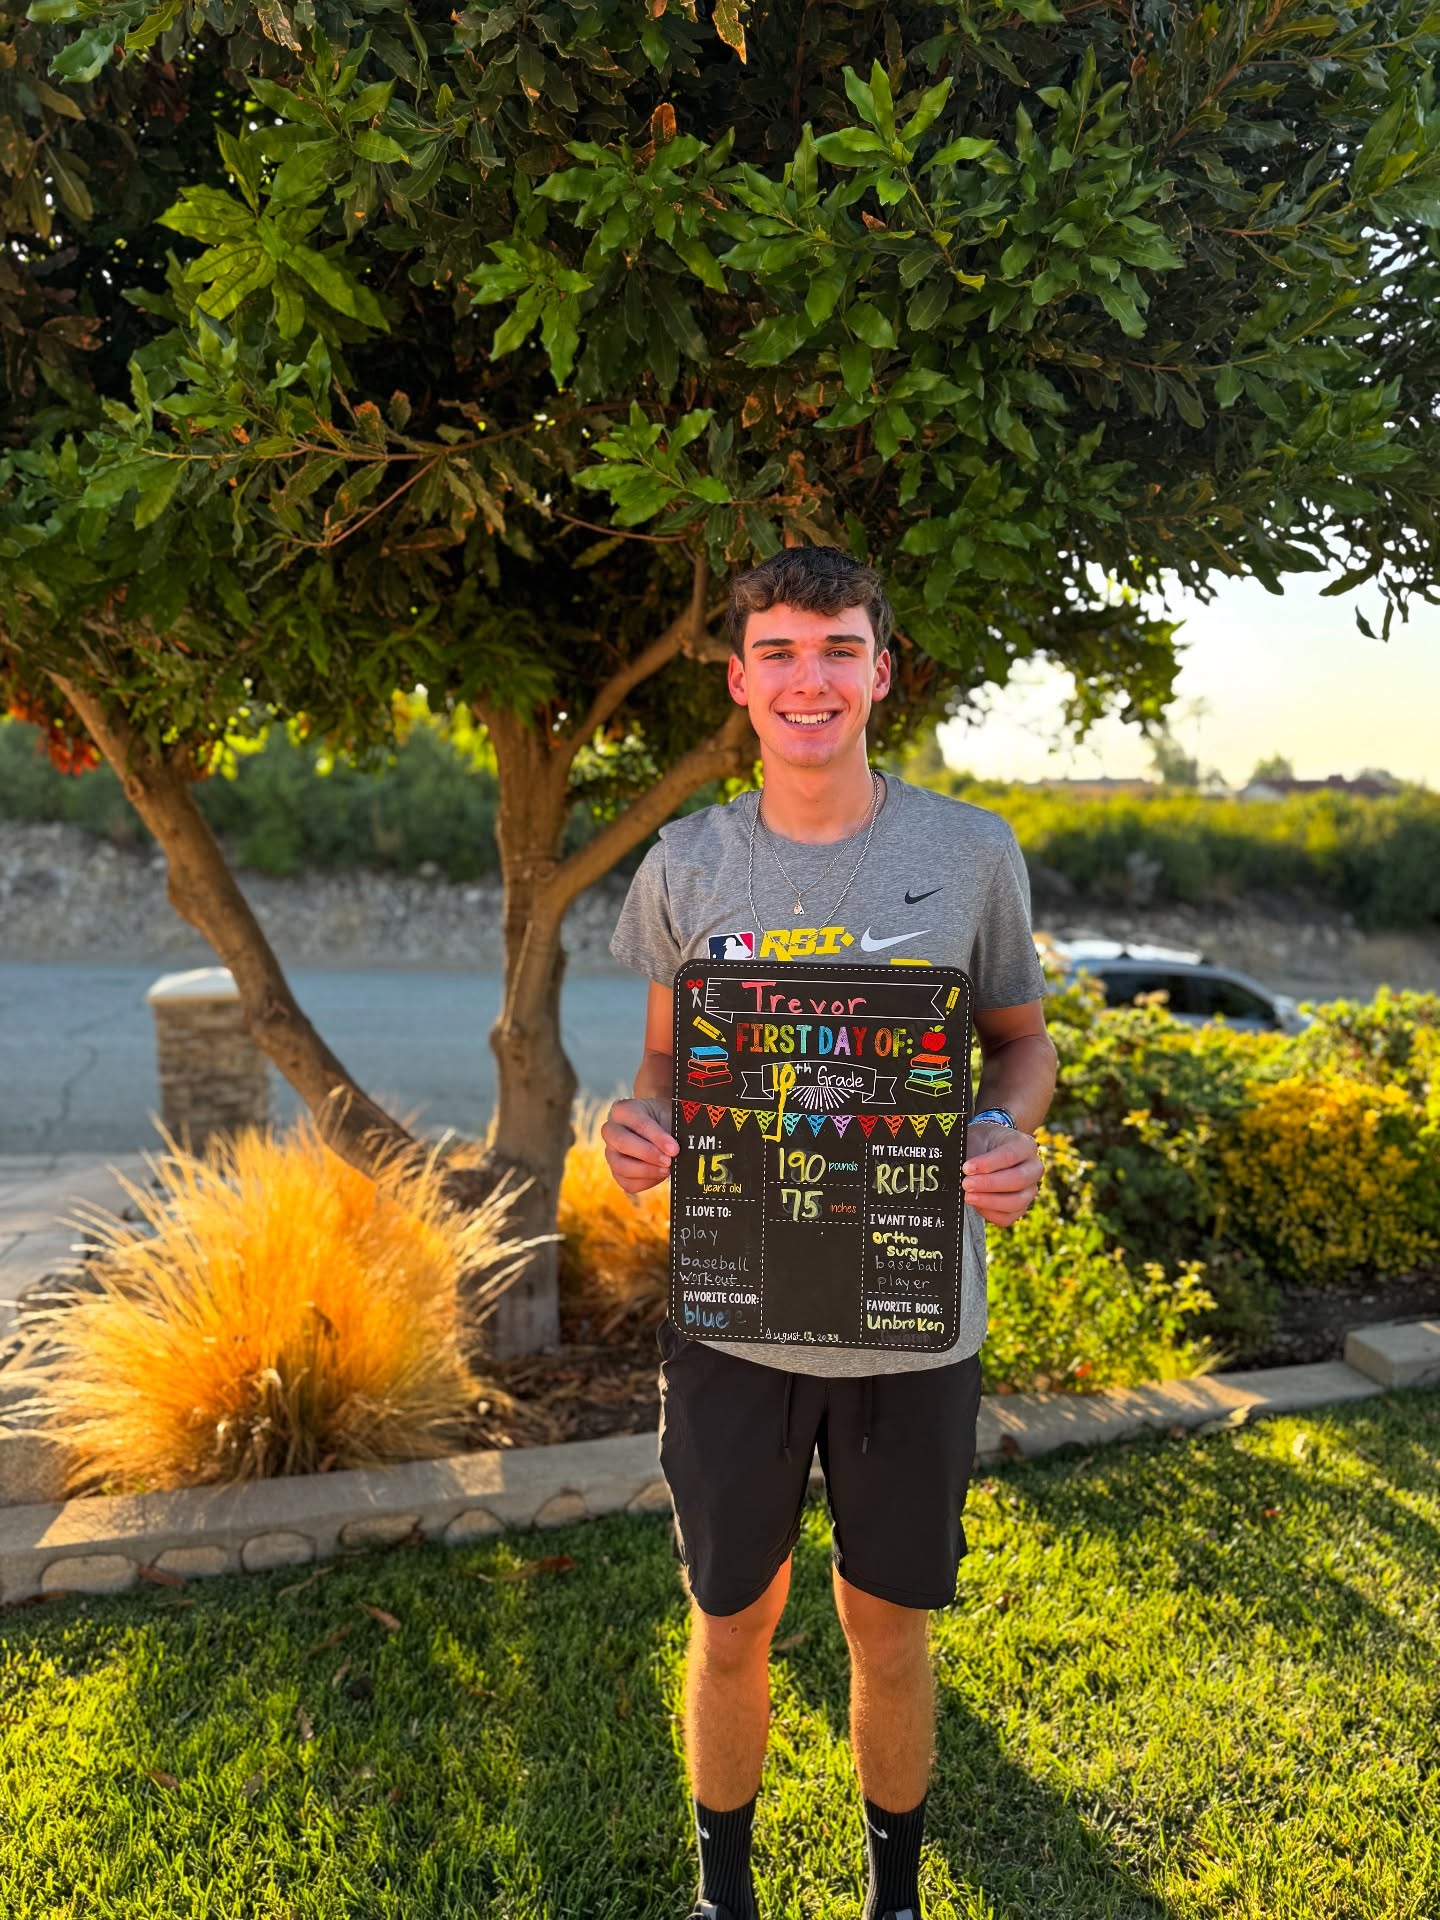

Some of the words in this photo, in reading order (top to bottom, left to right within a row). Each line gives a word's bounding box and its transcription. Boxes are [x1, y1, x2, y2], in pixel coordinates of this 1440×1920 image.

[759, 926, 845, 961] RBI
[741, 981, 867, 1015] Trevor
[736, 1023, 812, 1055] FIRST
[818, 1025, 868, 1057] DAY
[874, 1028, 913, 1057] OF:
[817, 1065, 864, 1088] Grade
[688, 1135, 695, 1149] I
[872, 1145, 885, 1156] MY
[887, 1145, 927, 1158] TEACHER
[928, 1147, 943, 1159] IS:
[698, 1153, 735, 1184] 15
[779, 1147, 827, 1182] 190
[828, 1160, 859, 1172] pounds
[876, 1163, 940, 1195] RCHS
[703, 1183, 726, 1194] years
[729, 1183, 742, 1193] old
[685, 1205, 691, 1216] I
[692, 1205, 715, 1217] LOVE
[717, 1206, 732, 1217] TO:
[781, 1188, 824, 1221] 75
[830, 1202, 857, 1214] inches
[870, 1213, 875, 1224] I
[877, 1213, 906, 1226] WANT
[908, 1215, 920, 1227] TO
[922, 1216, 933, 1227] BE
[935, 1217, 945, 1228] A:
[680, 1223, 718, 1246] play
[681, 1253, 749, 1272] baseball
[875, 1255, 943, 1272] baseball
[878, 1273, 930, 1291] player
[683, 1290, 727, 1303] FAVORITE
[729, 1292, 760, 1305] COLOR:
[684, 1302, 730, 1329] blue
[866, 1299, 912, 1313] FAVORITE
[915, 1303, 943, 1315] BOOK:
[765, 1327, 801, 1343] August
